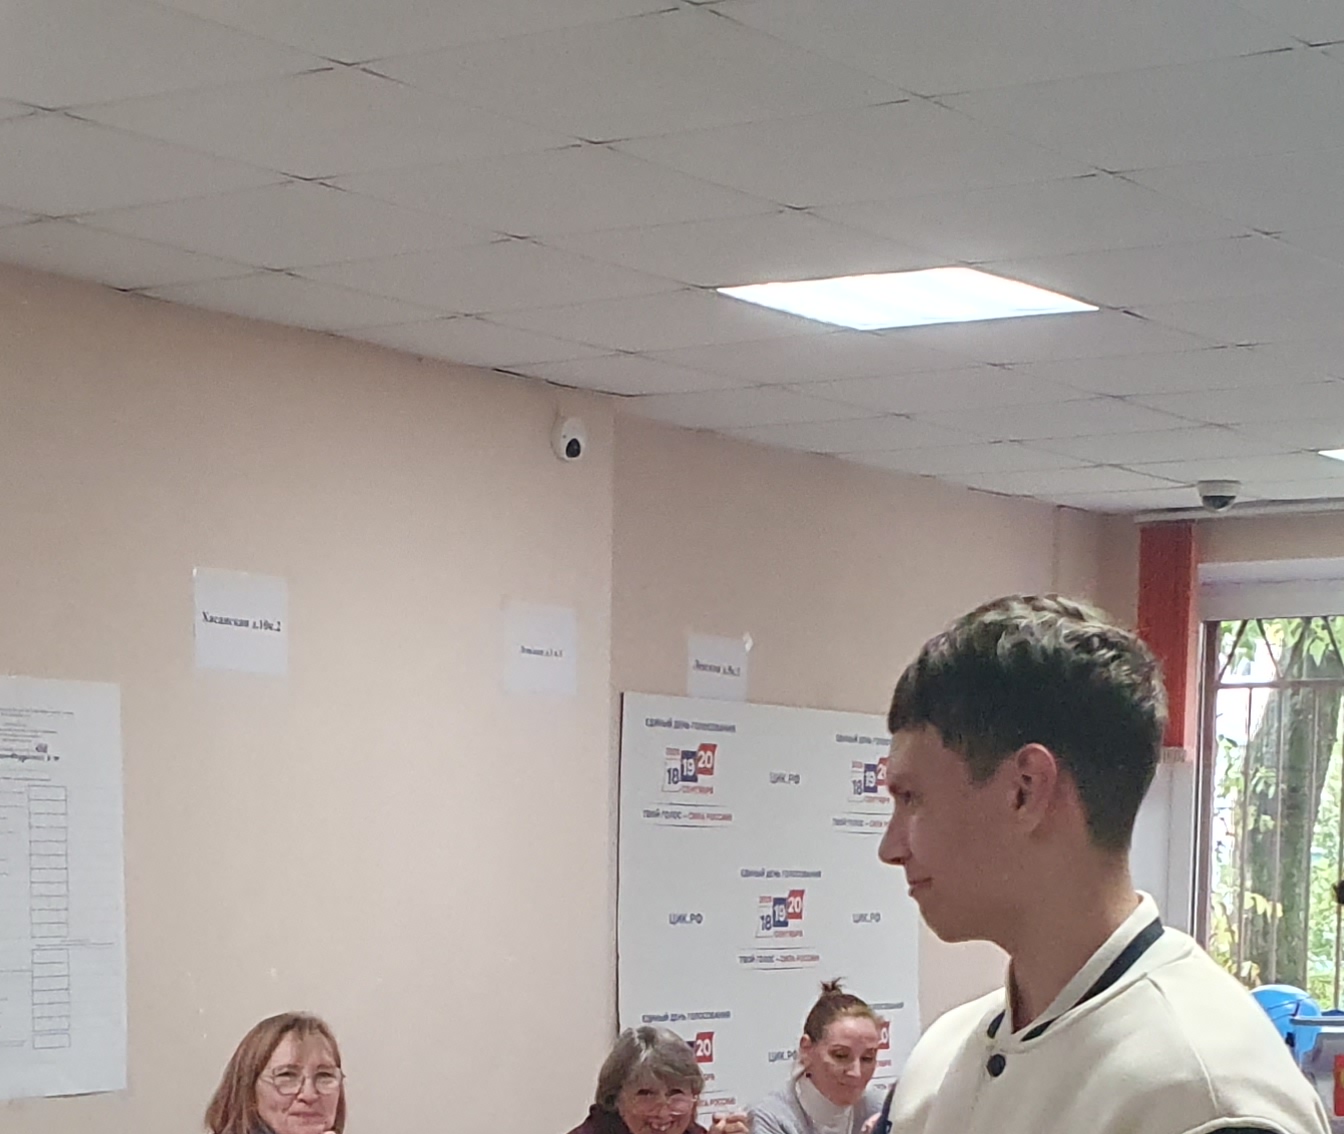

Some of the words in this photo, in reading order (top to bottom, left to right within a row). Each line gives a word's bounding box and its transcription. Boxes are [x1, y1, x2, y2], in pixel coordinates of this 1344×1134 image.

[666, 767, 680, 785] 18
[682, 758, 695, 776] 19
[698, 750, 714, 769] 20
[852, 779, 862, 795] 18
[864, 771, 876, 787] 19
[669, 912, 704, 925] ЦИК.РФ
[760, 914, 772, 931] 18
[774, 904, 786, 922] 19
[787, 896, 803, 913] 20
[696, 1038, 711, 1057] 20
